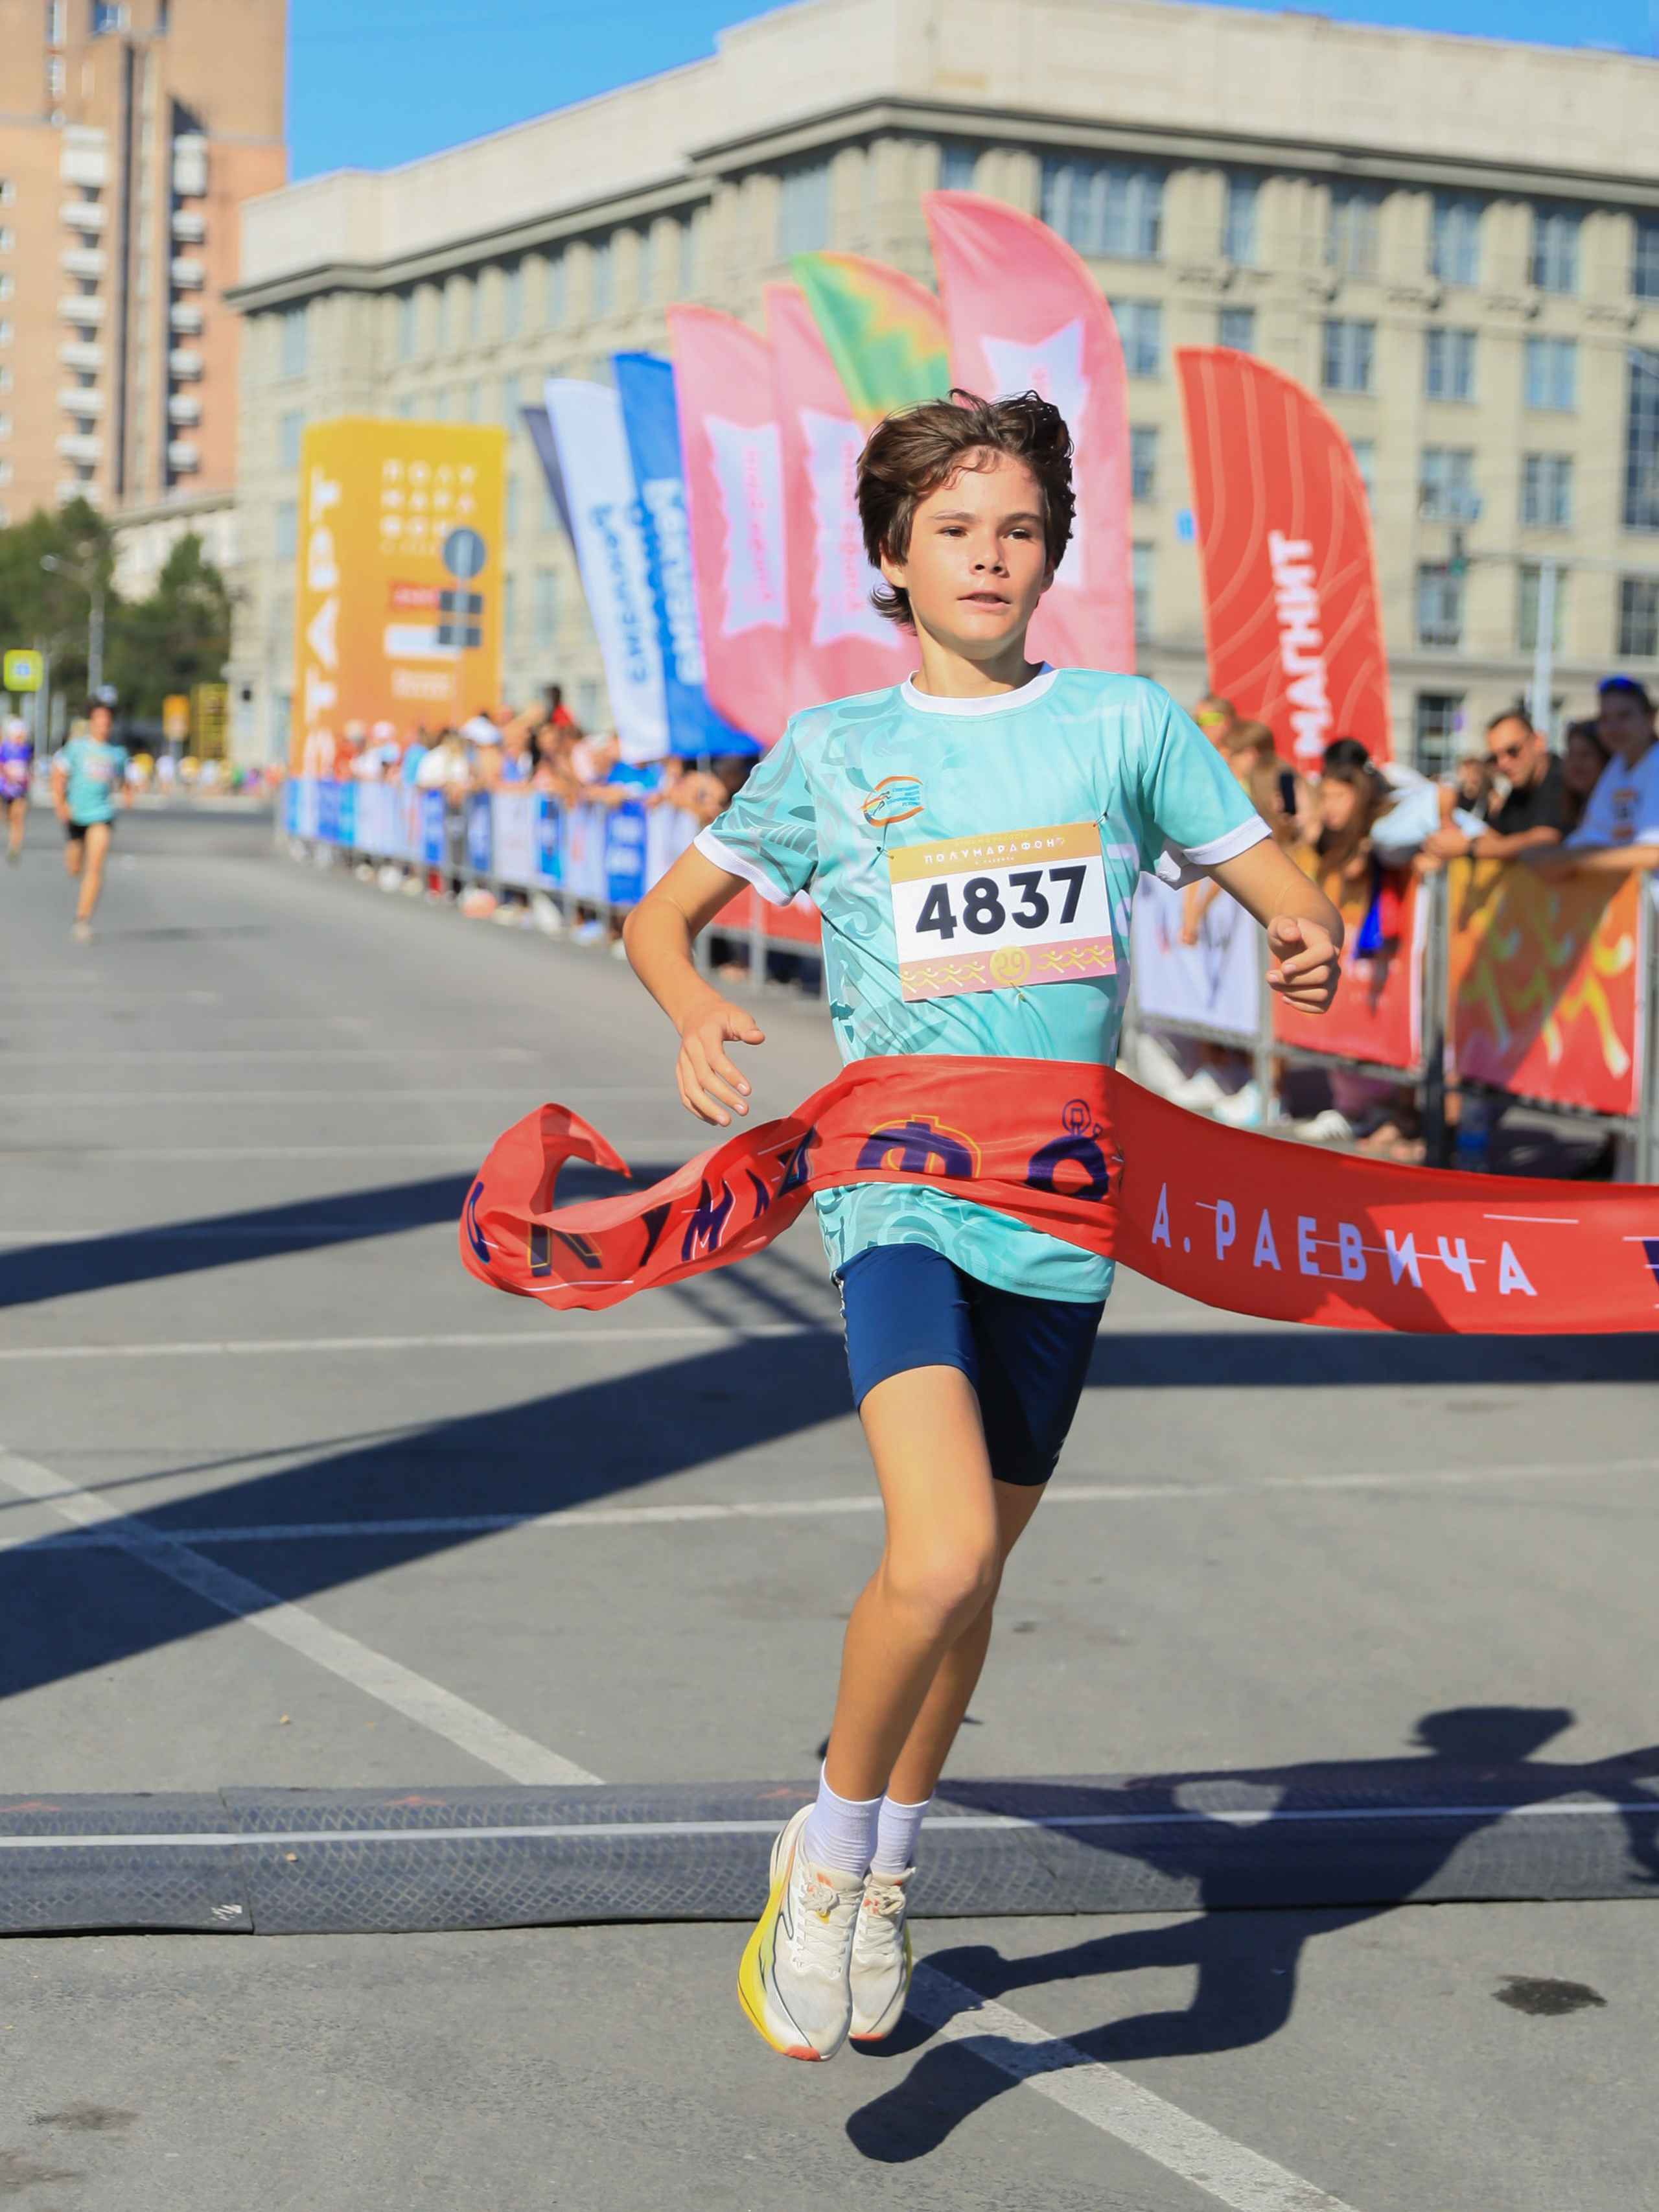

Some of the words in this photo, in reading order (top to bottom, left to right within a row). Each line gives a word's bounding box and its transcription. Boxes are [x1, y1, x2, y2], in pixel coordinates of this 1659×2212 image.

[1266, 529, 1333, 759] МАГНИТ
[924, 838, 1054, 864] ПОЛУМАРАФОН
[915, 865, 1087, 940] 4837
[1215, 1199, 1537, 1296] РАЕВИЧА
